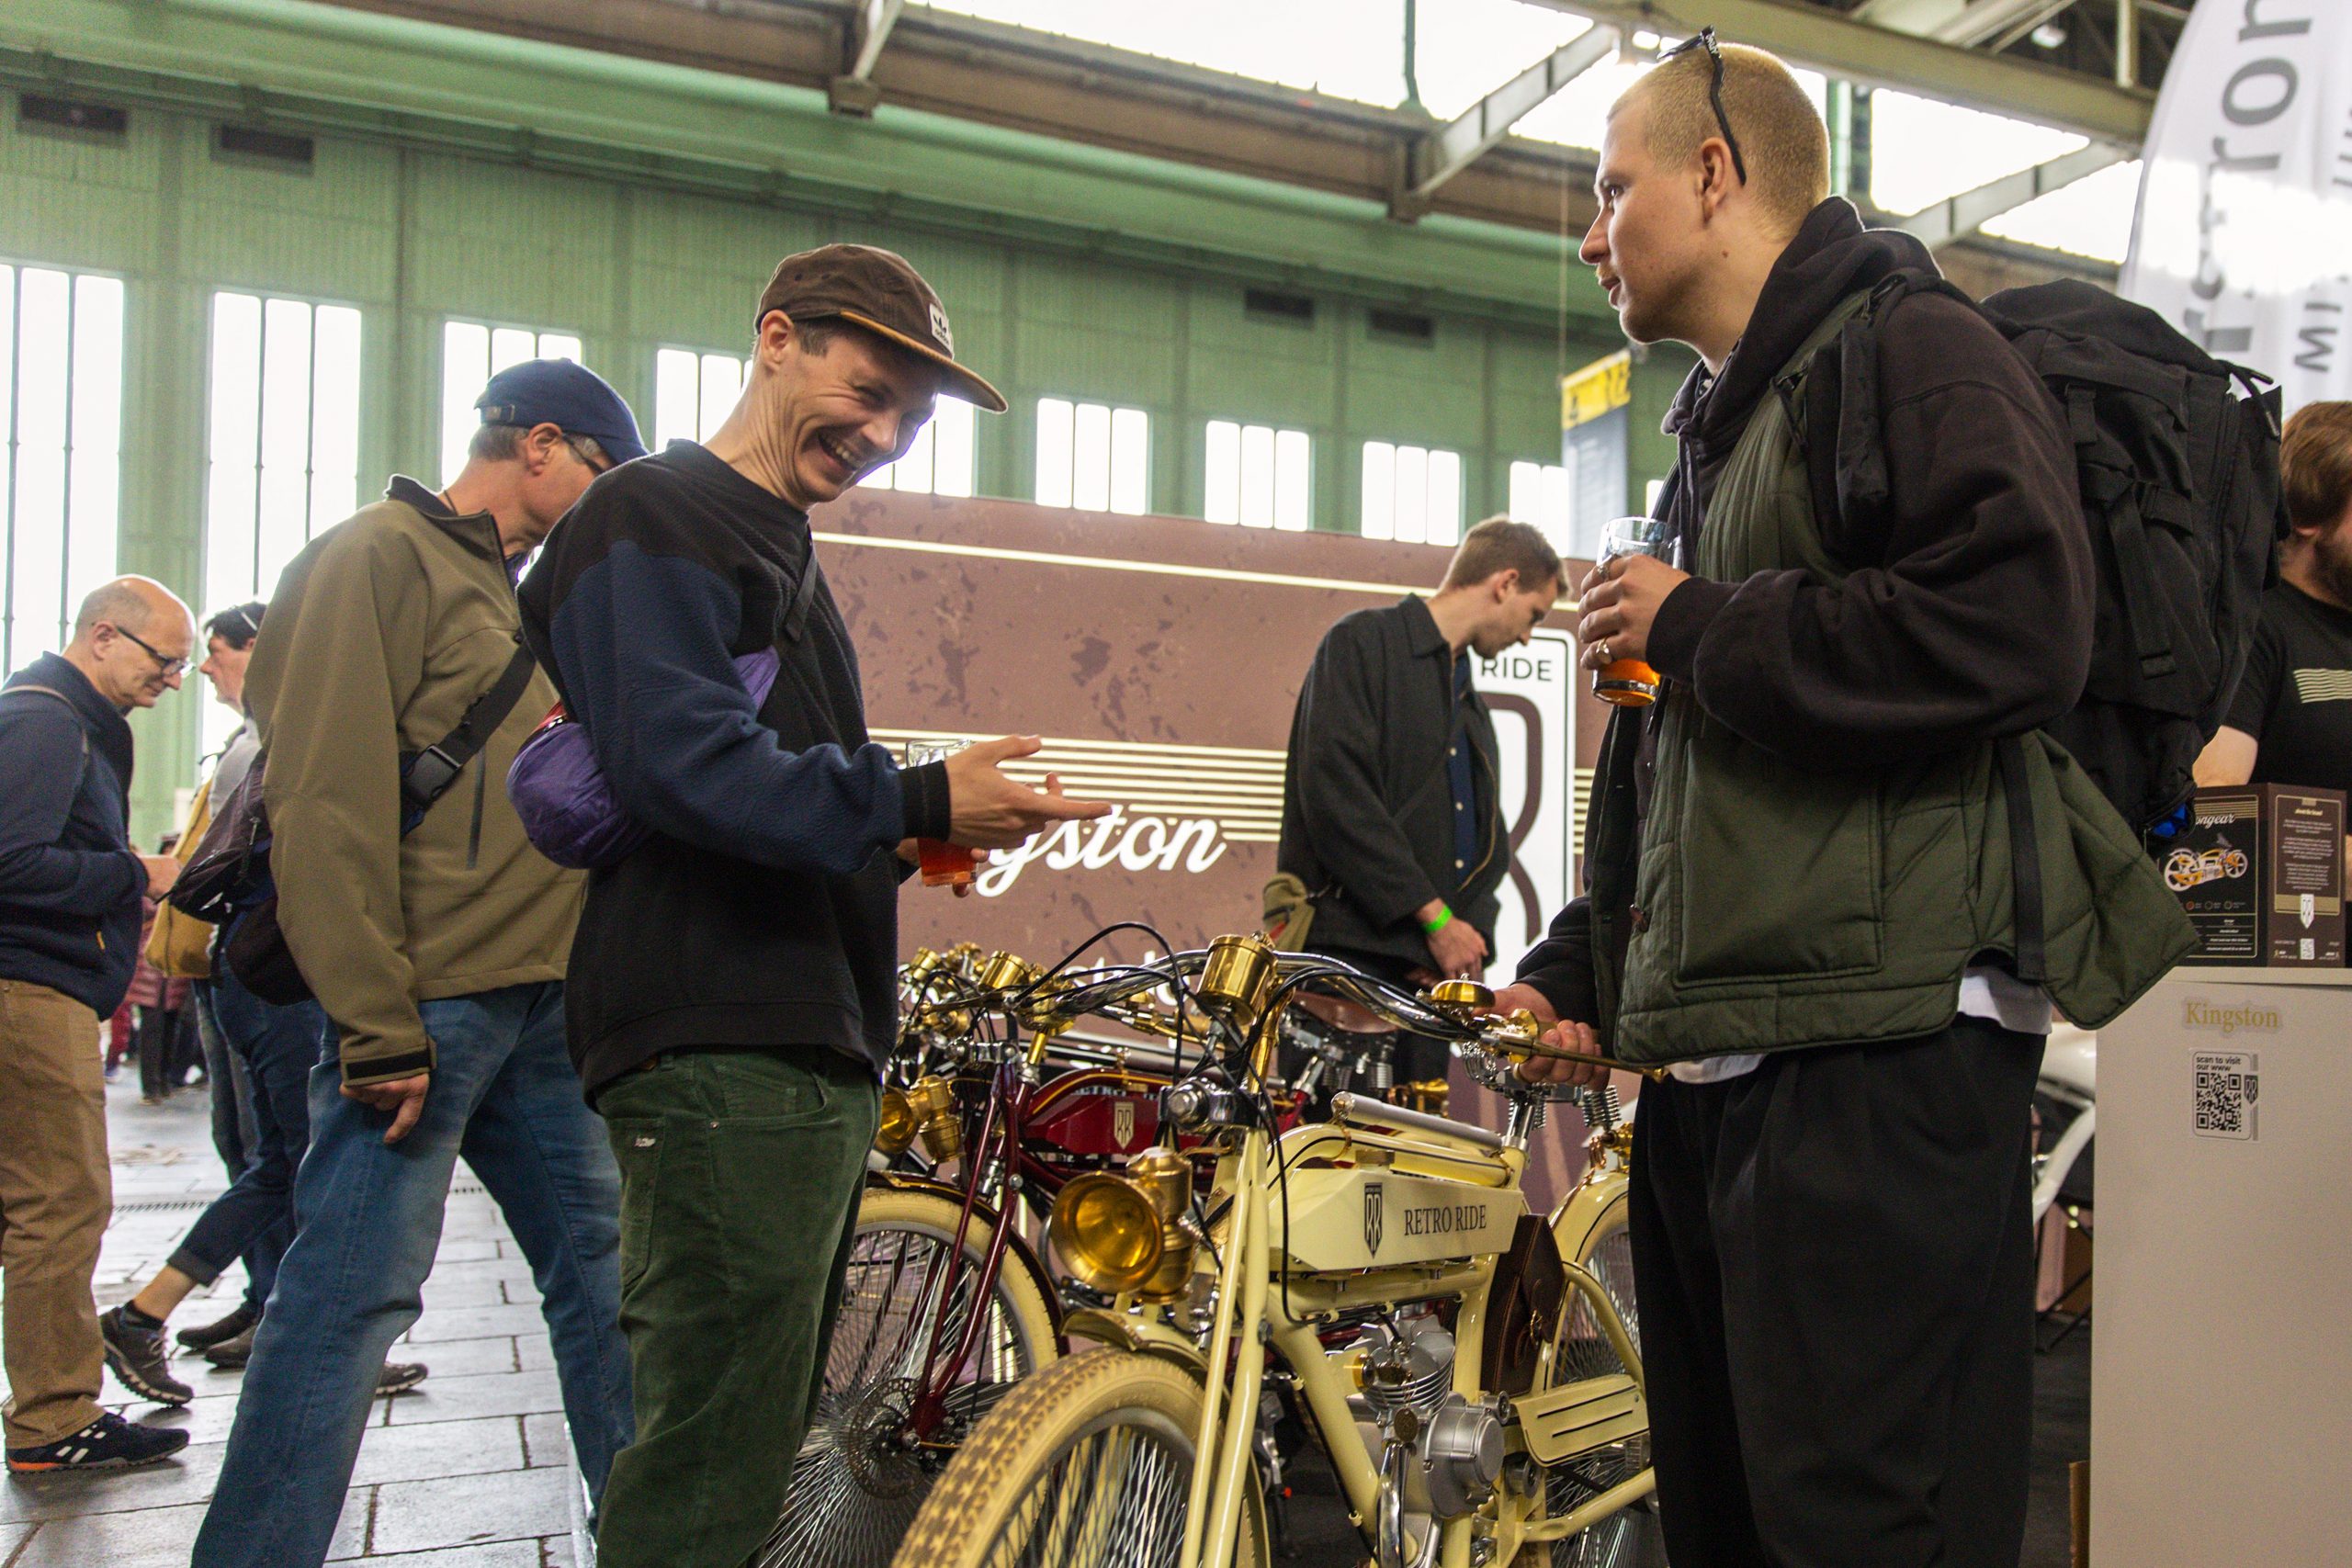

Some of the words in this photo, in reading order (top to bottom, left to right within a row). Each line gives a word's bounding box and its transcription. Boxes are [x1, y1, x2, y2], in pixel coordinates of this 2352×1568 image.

[1481, 658, 1552, 681] RIDE
[2186, 1002, 2278, 1032] Kingston
[2225, 1056, 2242, 1065] visit
[1404, 1207, 1452, 1235] RETRO
[1455, 1205, 1487, 1231] RIDE
